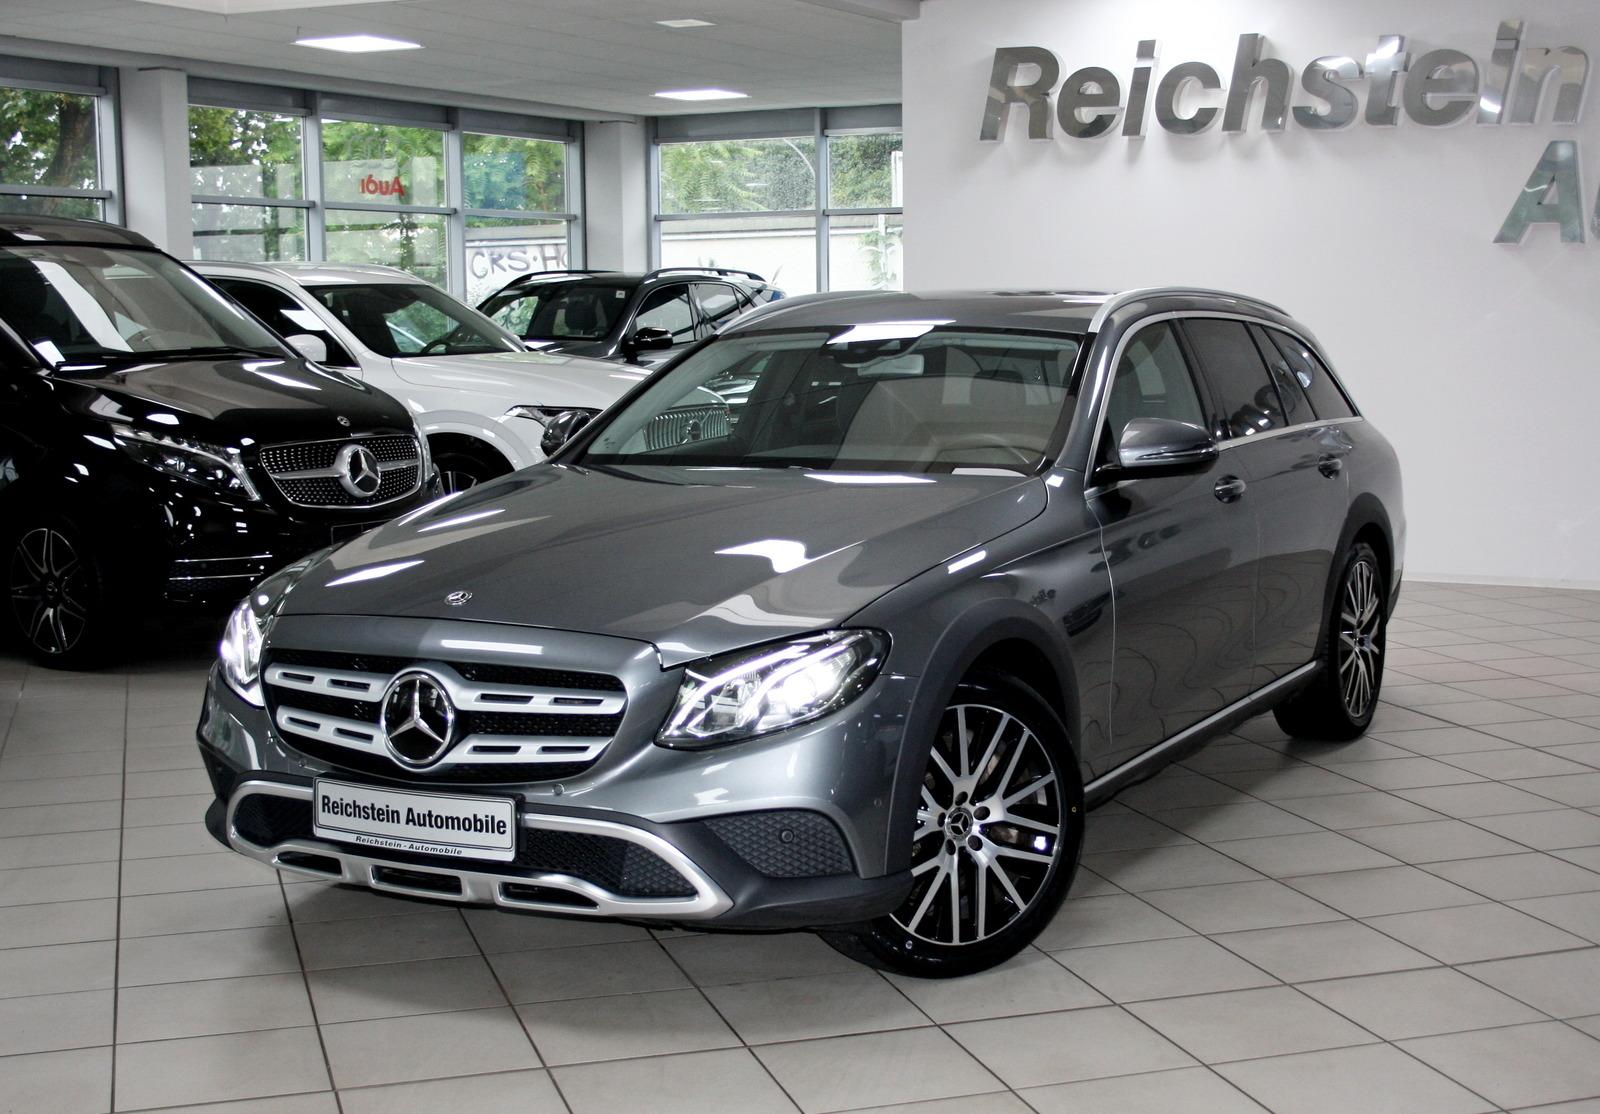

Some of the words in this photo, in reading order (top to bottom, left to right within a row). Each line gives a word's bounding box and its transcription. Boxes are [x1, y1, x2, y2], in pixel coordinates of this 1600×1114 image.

[980, 21, 1588, 141] Reichstein
[1492, 140, 1600, 243] A
[322, 795, 401, 825] Reichstein
[405, 807, 507, 835] Automobile
